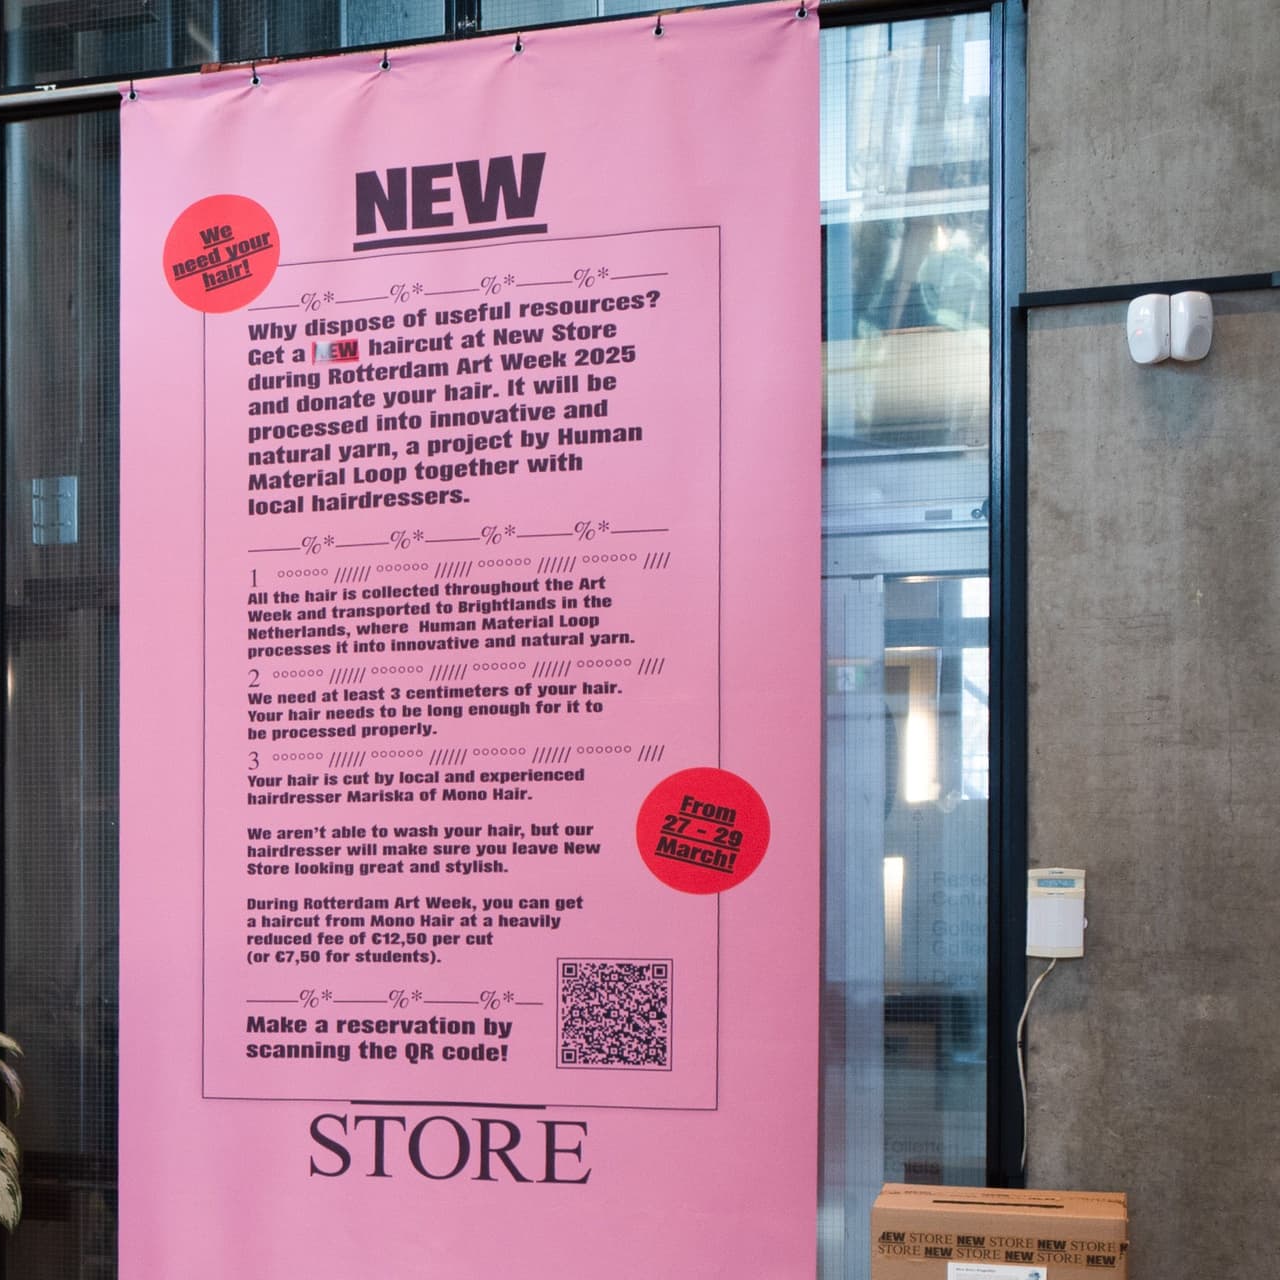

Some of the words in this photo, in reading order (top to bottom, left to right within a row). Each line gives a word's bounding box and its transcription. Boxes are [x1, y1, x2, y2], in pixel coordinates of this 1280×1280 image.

[355, 152, 546, 236] NEW
[200, 224, 233, 247] We
[172, 248, 221, 277] need
[225, 231, 271, 260] your
[202, 258, 251, 288] hair!
[248, 322, 297, 341] Why
[304, 314, 395, 336] dispose
[402, 308, 427, 327] of
[435, 301, 510, 325] useful
[519, 290, 660, 317] resources?
[248, 345, 284, 366] Get
[292, 349, 305, 362] a
[316, 341, 358, 361] EW
[368, 331, 453, 356] haircut
[460, 328, 485, 348] at
[493, 327, 544, 345] New
[551, 321, 616, 341] Store
[247, 371, 320, 391] during
[328, 360, 448, 384] Rotterdam
[456, 353, 492, 375] Art
[500, 350, 566, 370] Week
[574, 344, 635, 366] 2025
[248, 396, 288, 416] and
[296, 389, 375, 412] donate
[382, 388, 436, 408] your
[444, 381, 499, 401] hair.
[507, 376, 525, 396] It
[533, 374, 578, 394] will
[587, 373, 616, 391] be
[248, 415, 368, 443] processed
[376, 411, 421, 431] into
[430, 403, 555, 428] innovative
[563, 398, 607, 419] and
[248, 443, 330, 466] natural
[338, 442, 397, 462] yarn,
[405, 440, 419, 455] a
[427, 429, 513, 456] project
[520, 429, 549, 449] by
[557, 426, 642, 445] Human
[248, 467, 345, 490] Material
[353, 466, 406, 484] Loop
[414, 457, 519, 481] together
[526, 452, 582, 472] with
[248, 495, 303, 515] local
[311, 488, 469, 512] hairdressers.
[247, 591, 268, 605] All
[272, 591, 299, 603] the
[304, 588, 337, 602] hair
[342, 588, 356, 600] is
[361, 583, 439, 599] collected
[444, 577, 539, 595] throughout
[544, 578, 573, 591] the
[578, 575, 606, 590] Art
[250, 569, 258, 588] 1
[247, 609, 291, 622] Week
[296, 606, 326, 620] and
[331, 602, 430, 618] transported
[435, 600, 452, 614] to
[458, 596, 556, 614] Brightlands
[561, 596, 577, 608] in
[582, 594, 611, 608] the
[247, 623, 350, 640] Netherlands,
[356, 622, 408, 635] where
[419, 620, 475, 632] Human
[481, 614, 553, 630] Material
[559, 614, 599, 628] Loop
[248, 669, 260, 687] 2
[248, 751, 260, 770] 3
[247, 775, 282, 787] Your
[287, 773, 319, 786] hair
[323, 773, 338, 785] is
[342, 771, 369, 785] cut
[374, 771, 394, 786] by
[399, 770, 439, 783] local
[444, 769, 474, 783] and
[479, 768, 584, 784] experienced
[247, 791, 341, 805] hairdresser
[346, 789, 413, 802] Mariska
[419, 788, 436, 801] of
[442, 788, 487, 800] Mono
[492, 787, 532, 800] Hair.
[680, 795, 737, 823] From
[247, 827, 271, 839] We
[331, 825, 366, 838] able
[371, 824, 388, 838] to
[393, 824, 438, 837] wash
[443, 826, 482, 839] your
[487, 823, 524, 839] hair,
[530, 822, 559, 836] but
[564, 825, 593, 836] our
[661, 814, 691, 834] 27
[713, 827, 744, 847] 29
[656, 836, 738, 869] March!
[247, 897, 298, 912] During
[303, 896, 388, 909] Rotterdam
[394, 895, 420, 909] Art
[425, 896, 476, 911] Week,
[482, 898, 512, 911] you
[518, 898, 549, 909] can
[555, 895, 583, 911] get
[246, 932, 311, 945] reduced
[317, 931, 344, 944] fee
[348, 931, 366, 944] of
[371, 932, 426, 947] €12,50
[432, 934, 460, 946] per
[465, 931, 493, 945] cut
[246, 950, 270, 964] (or
[274, 950, 320, 965] €7,50
[325, 949, 350, 962] for
[355, 949, 441, 964] students).
[246, 1015, 307, 1033] Make
[314, 1019, 328, 1033] a
[336, 1015, 475, 1035] reservation
[483, 1017, 512, 1038] by
[246, 1041, 350, 1061] scanning
[357, 1039, 397, 1059] the
[404, 1042, 434, 1064] QR
[441, 1043, 507, 1061] code!
[309, 1113, 592, 1184] STORE
[878, 1245, 920, 1256] STORE
[925, 1247, 953, 1257] NEW
[956, 1248, 1000, 1260] STORE
[1005, 1251, 1034, 1261] NEW
[1037, 1253, 1081, 1264] STORE
[1087, 1255, 1116, 1265] NEW
[910, 1232, 952, 1245] STORE
[957, 1236, 985, 1246] NEW
[990, 1237, 1033, 1249] STORE
[1038, 1240, 1066, 1250] NEW
[1070, 1241, 1116, 1252] STORE
